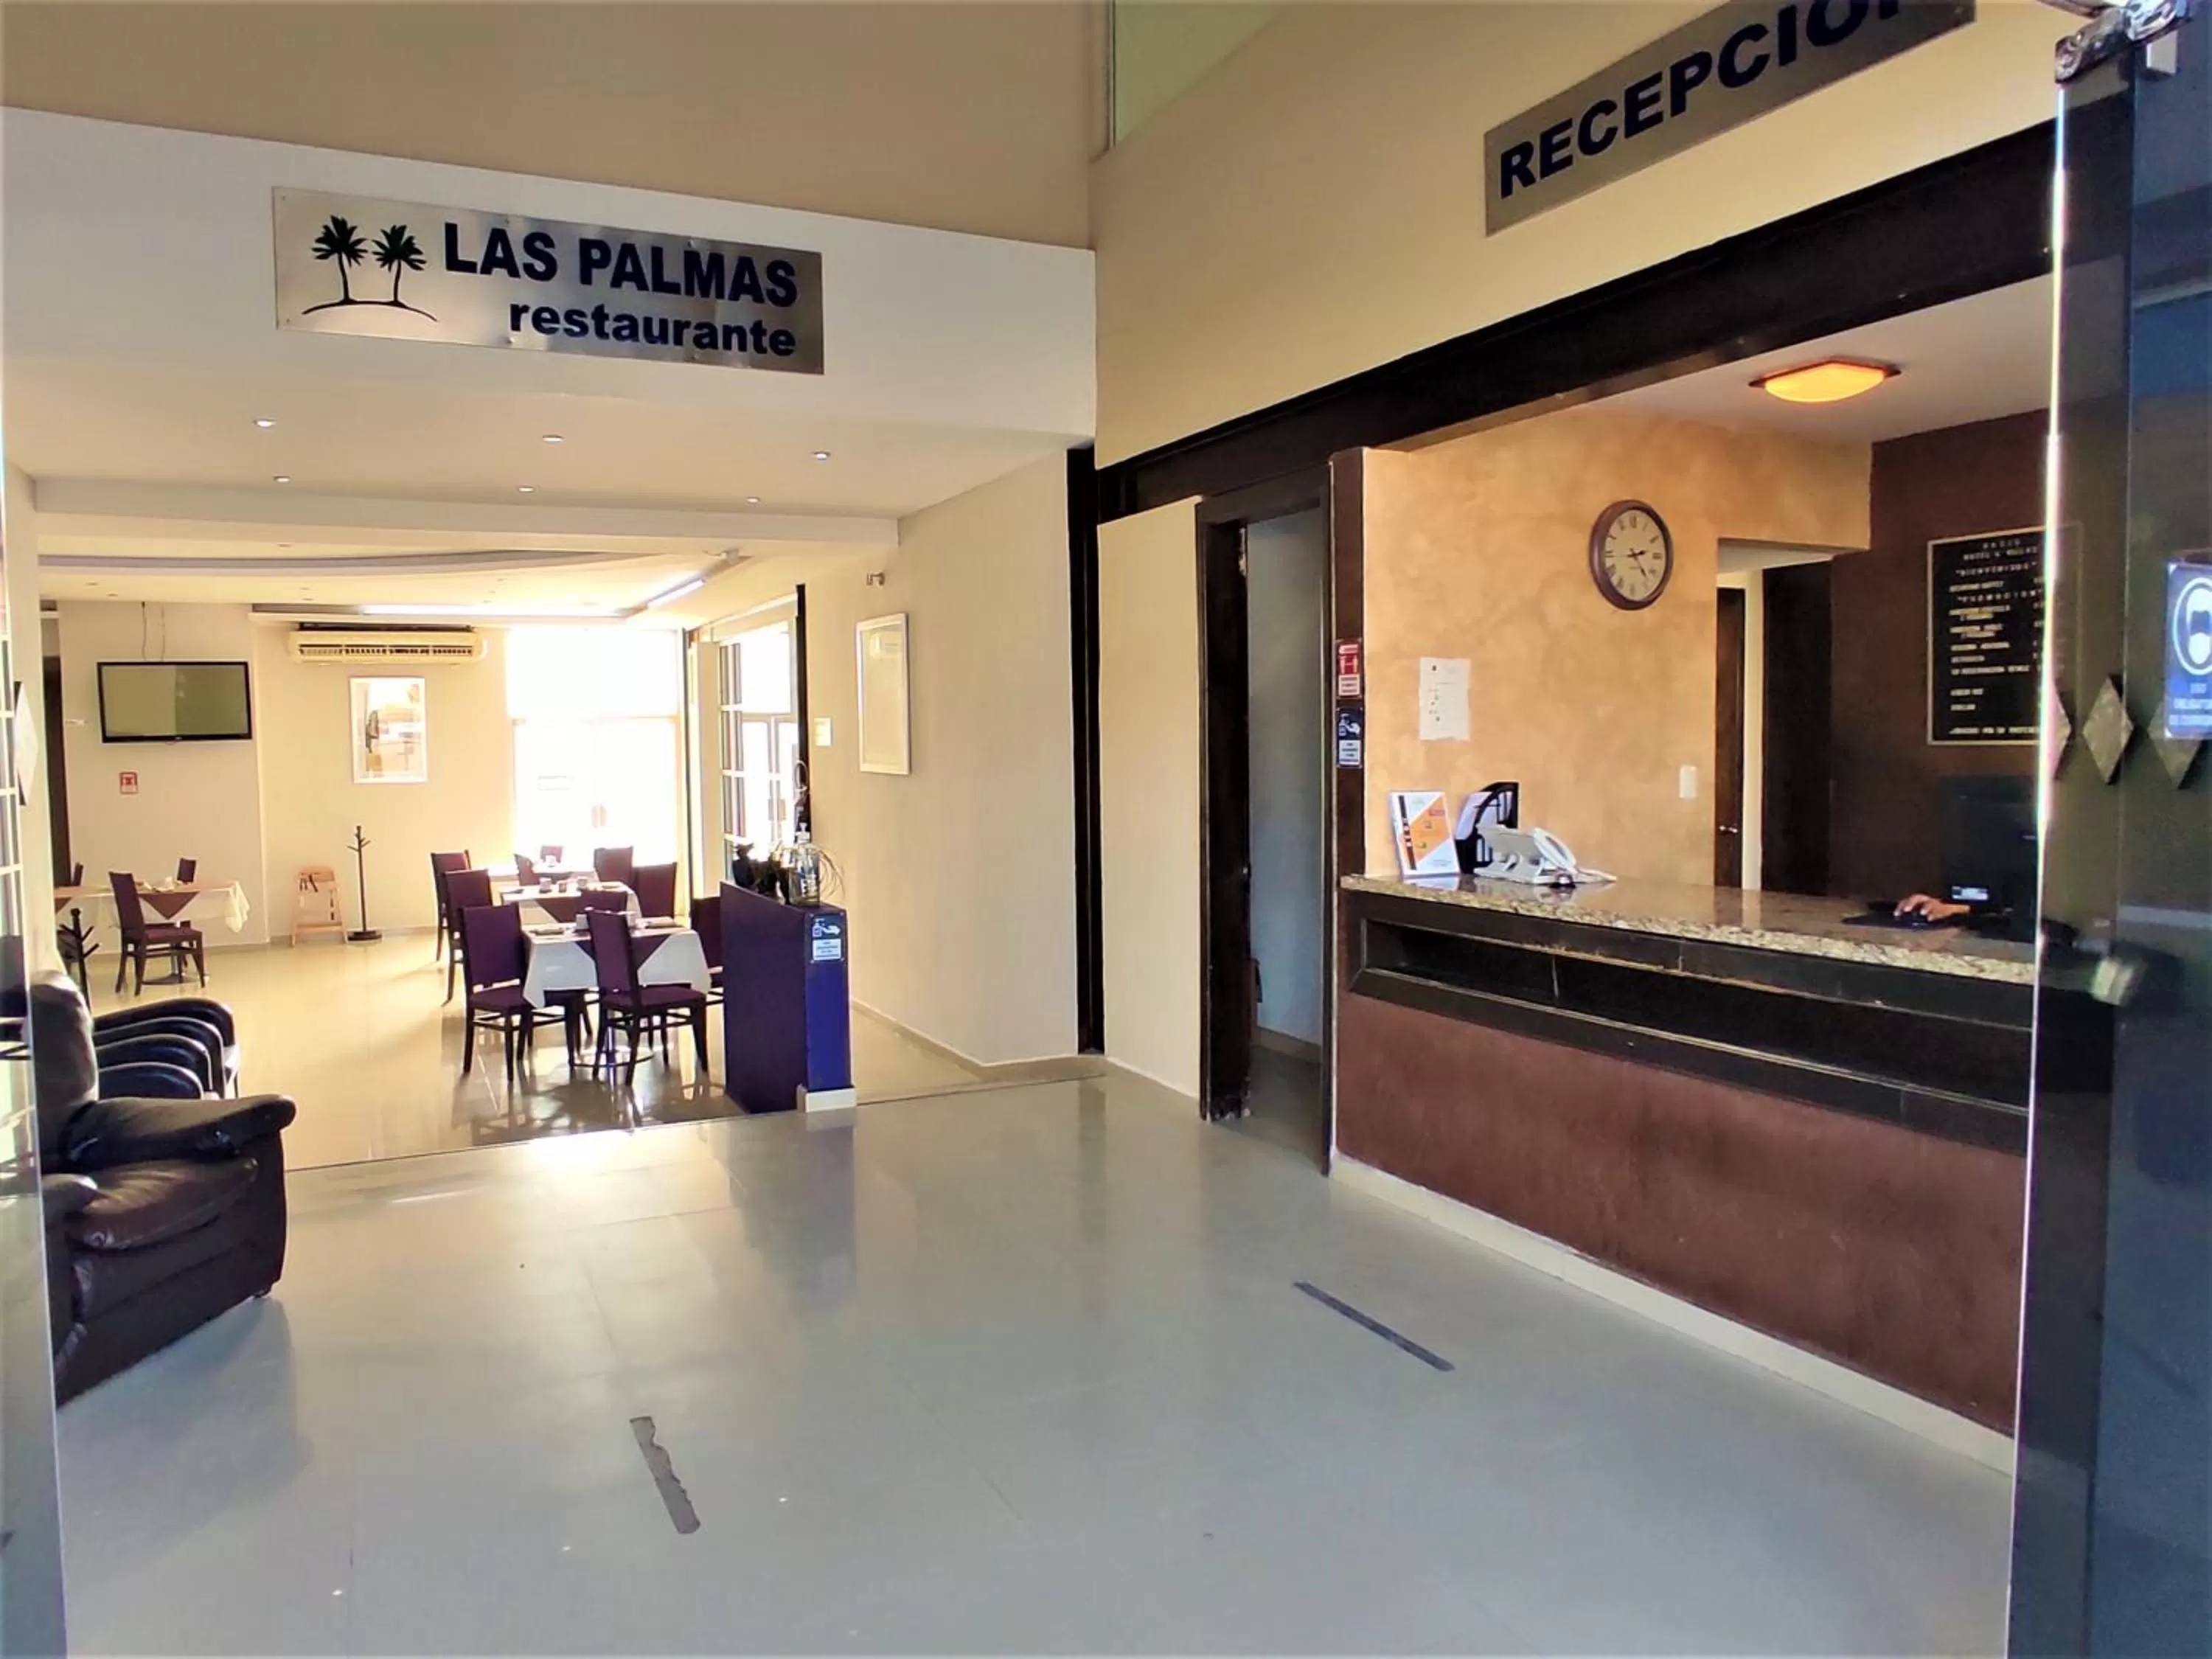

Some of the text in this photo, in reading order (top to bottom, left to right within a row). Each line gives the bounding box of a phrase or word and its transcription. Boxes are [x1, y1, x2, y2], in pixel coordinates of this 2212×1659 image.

[1500, 0, 1899, 199] RECEPCIO
[445, 222, 798, 307] LAS PALMAS
[509, 302, 797, 357] restaurante
